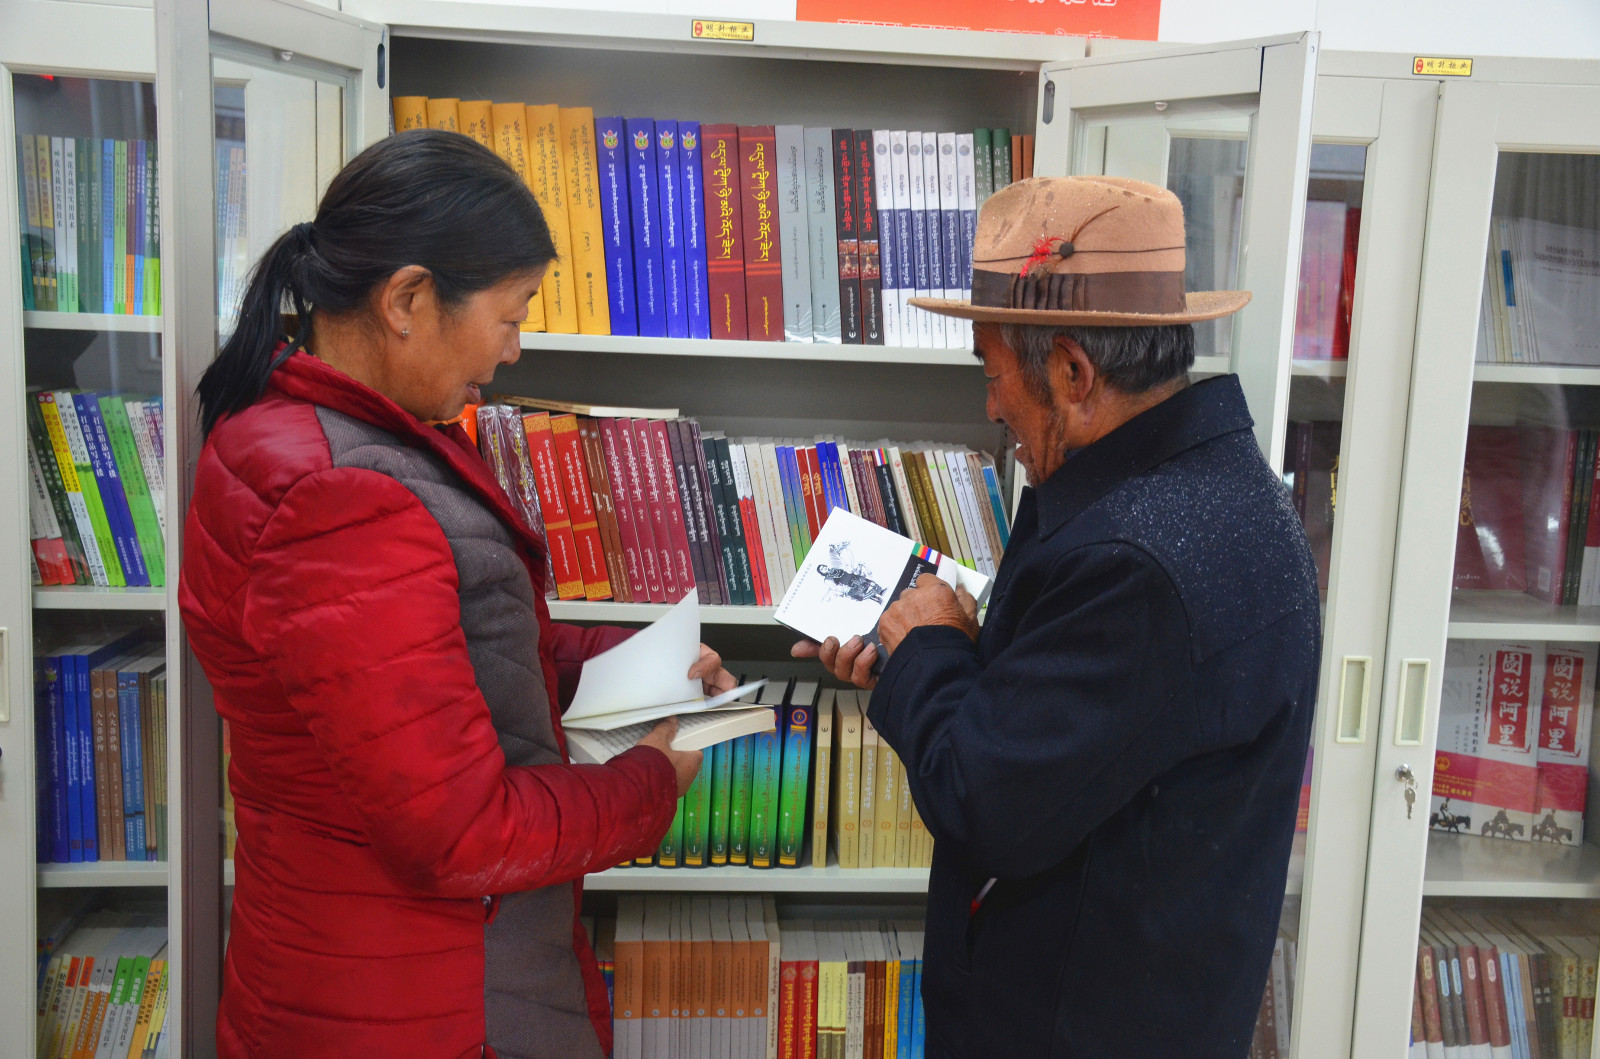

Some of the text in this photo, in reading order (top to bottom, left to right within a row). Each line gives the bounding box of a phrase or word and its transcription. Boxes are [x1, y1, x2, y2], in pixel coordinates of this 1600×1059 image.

[665, 846, 671, 854] 2
[692, 845, 697, 853] 1
[717, 844, 723, 852] 3
[736, 844, 742, 852] 4
[759, 847, 765, 855] 2
[786, 845, 791, 853] 1
